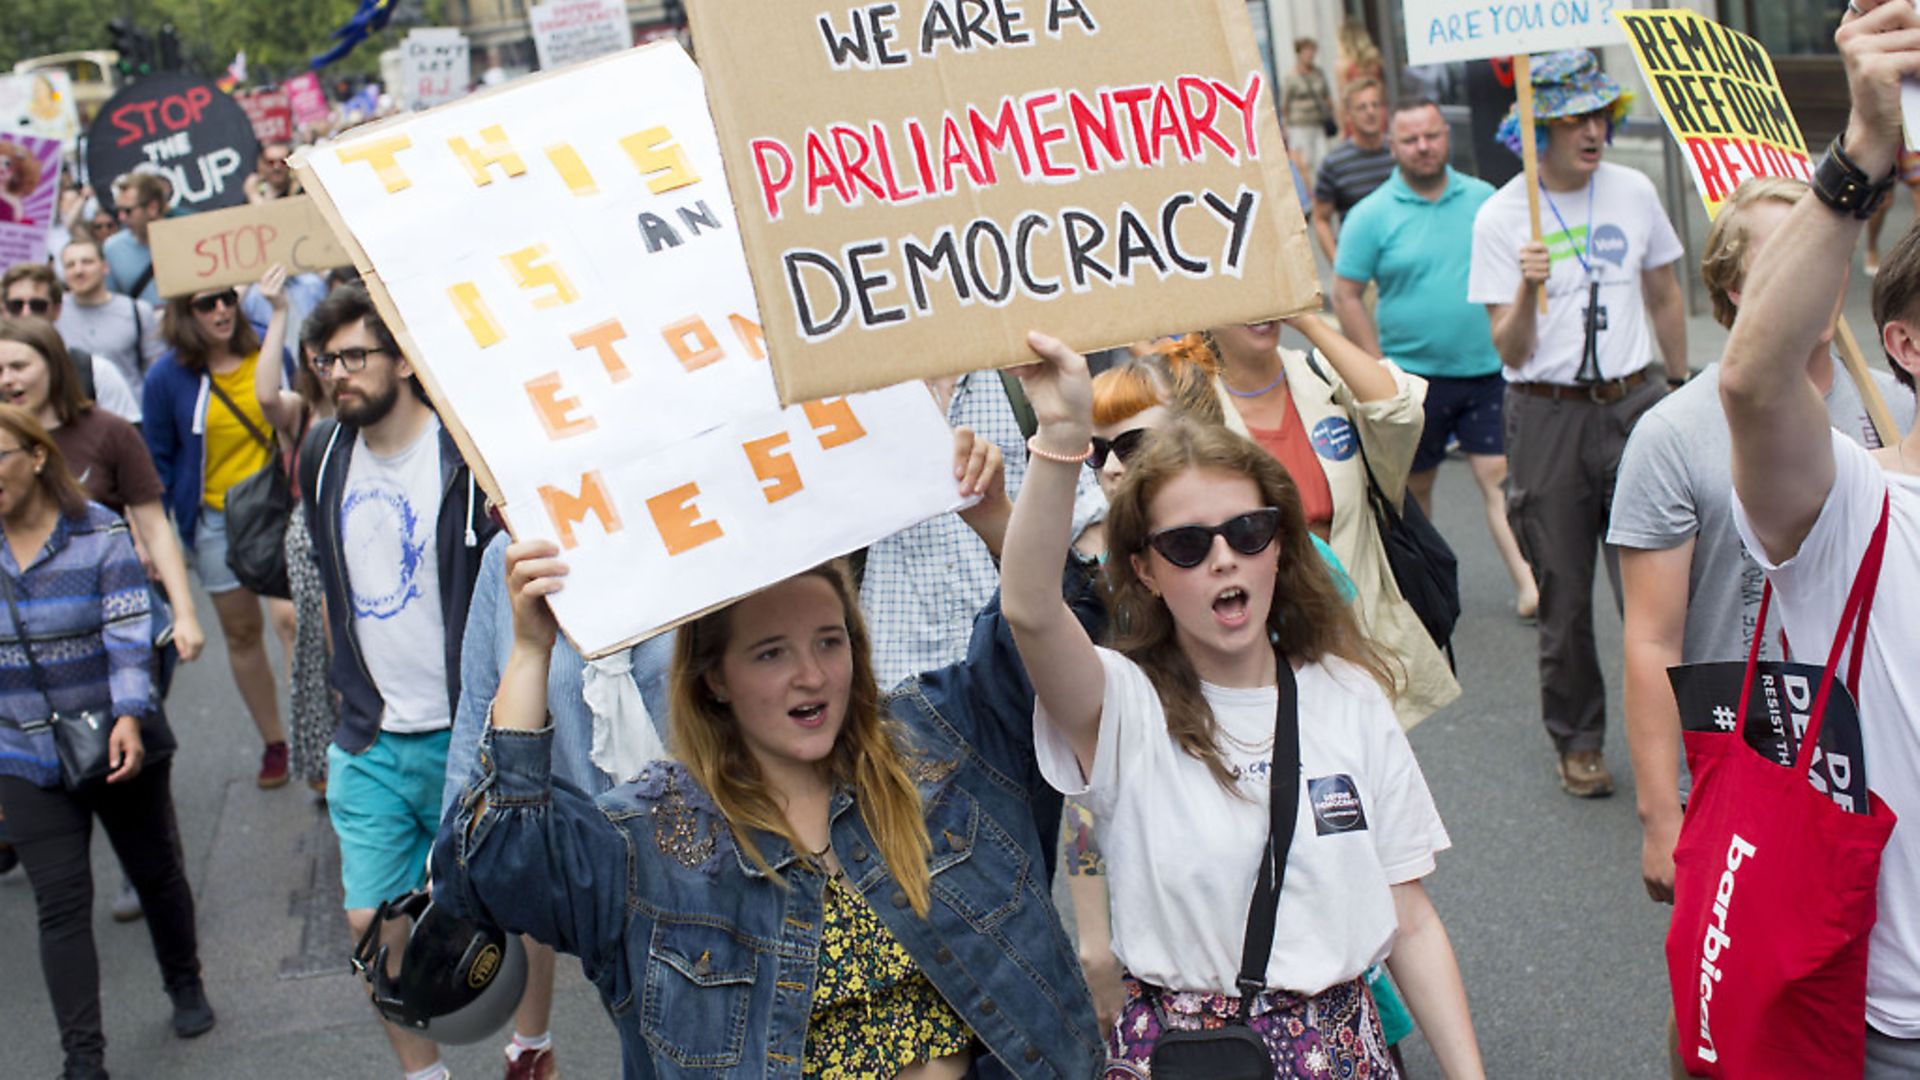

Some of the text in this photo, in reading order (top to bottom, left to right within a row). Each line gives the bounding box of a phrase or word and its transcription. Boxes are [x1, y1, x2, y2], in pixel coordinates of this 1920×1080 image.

[820, 0, 1096, 64] WE ARE A
[1429, 17, 1483, 45] ARE
[1488, 3, 1544, 34] YOU
[1551, 0, 1589, 27] ON
[1624, 15, 1773, 87] REMAIN
[111, 85, 213, 148] STOP
[142, 130, 193, 163] THE
[752, 74, 1261, 218] PARLIAMENTARY
[1654, 74, 1802, 149] REFORM
[335, 124, 702, 197] THIS
[194, 223, 278, 278] STOP
[637, 200, 722, 254] AN
[445, 243, 582, 350] IS
[784, 192, 1255, 337] DEMOCRACY
[537, 395, 867, 557] MESS
[1761, 675, 1786, 737] RESIST
[1697, 834, 1757, 1063] barbican
